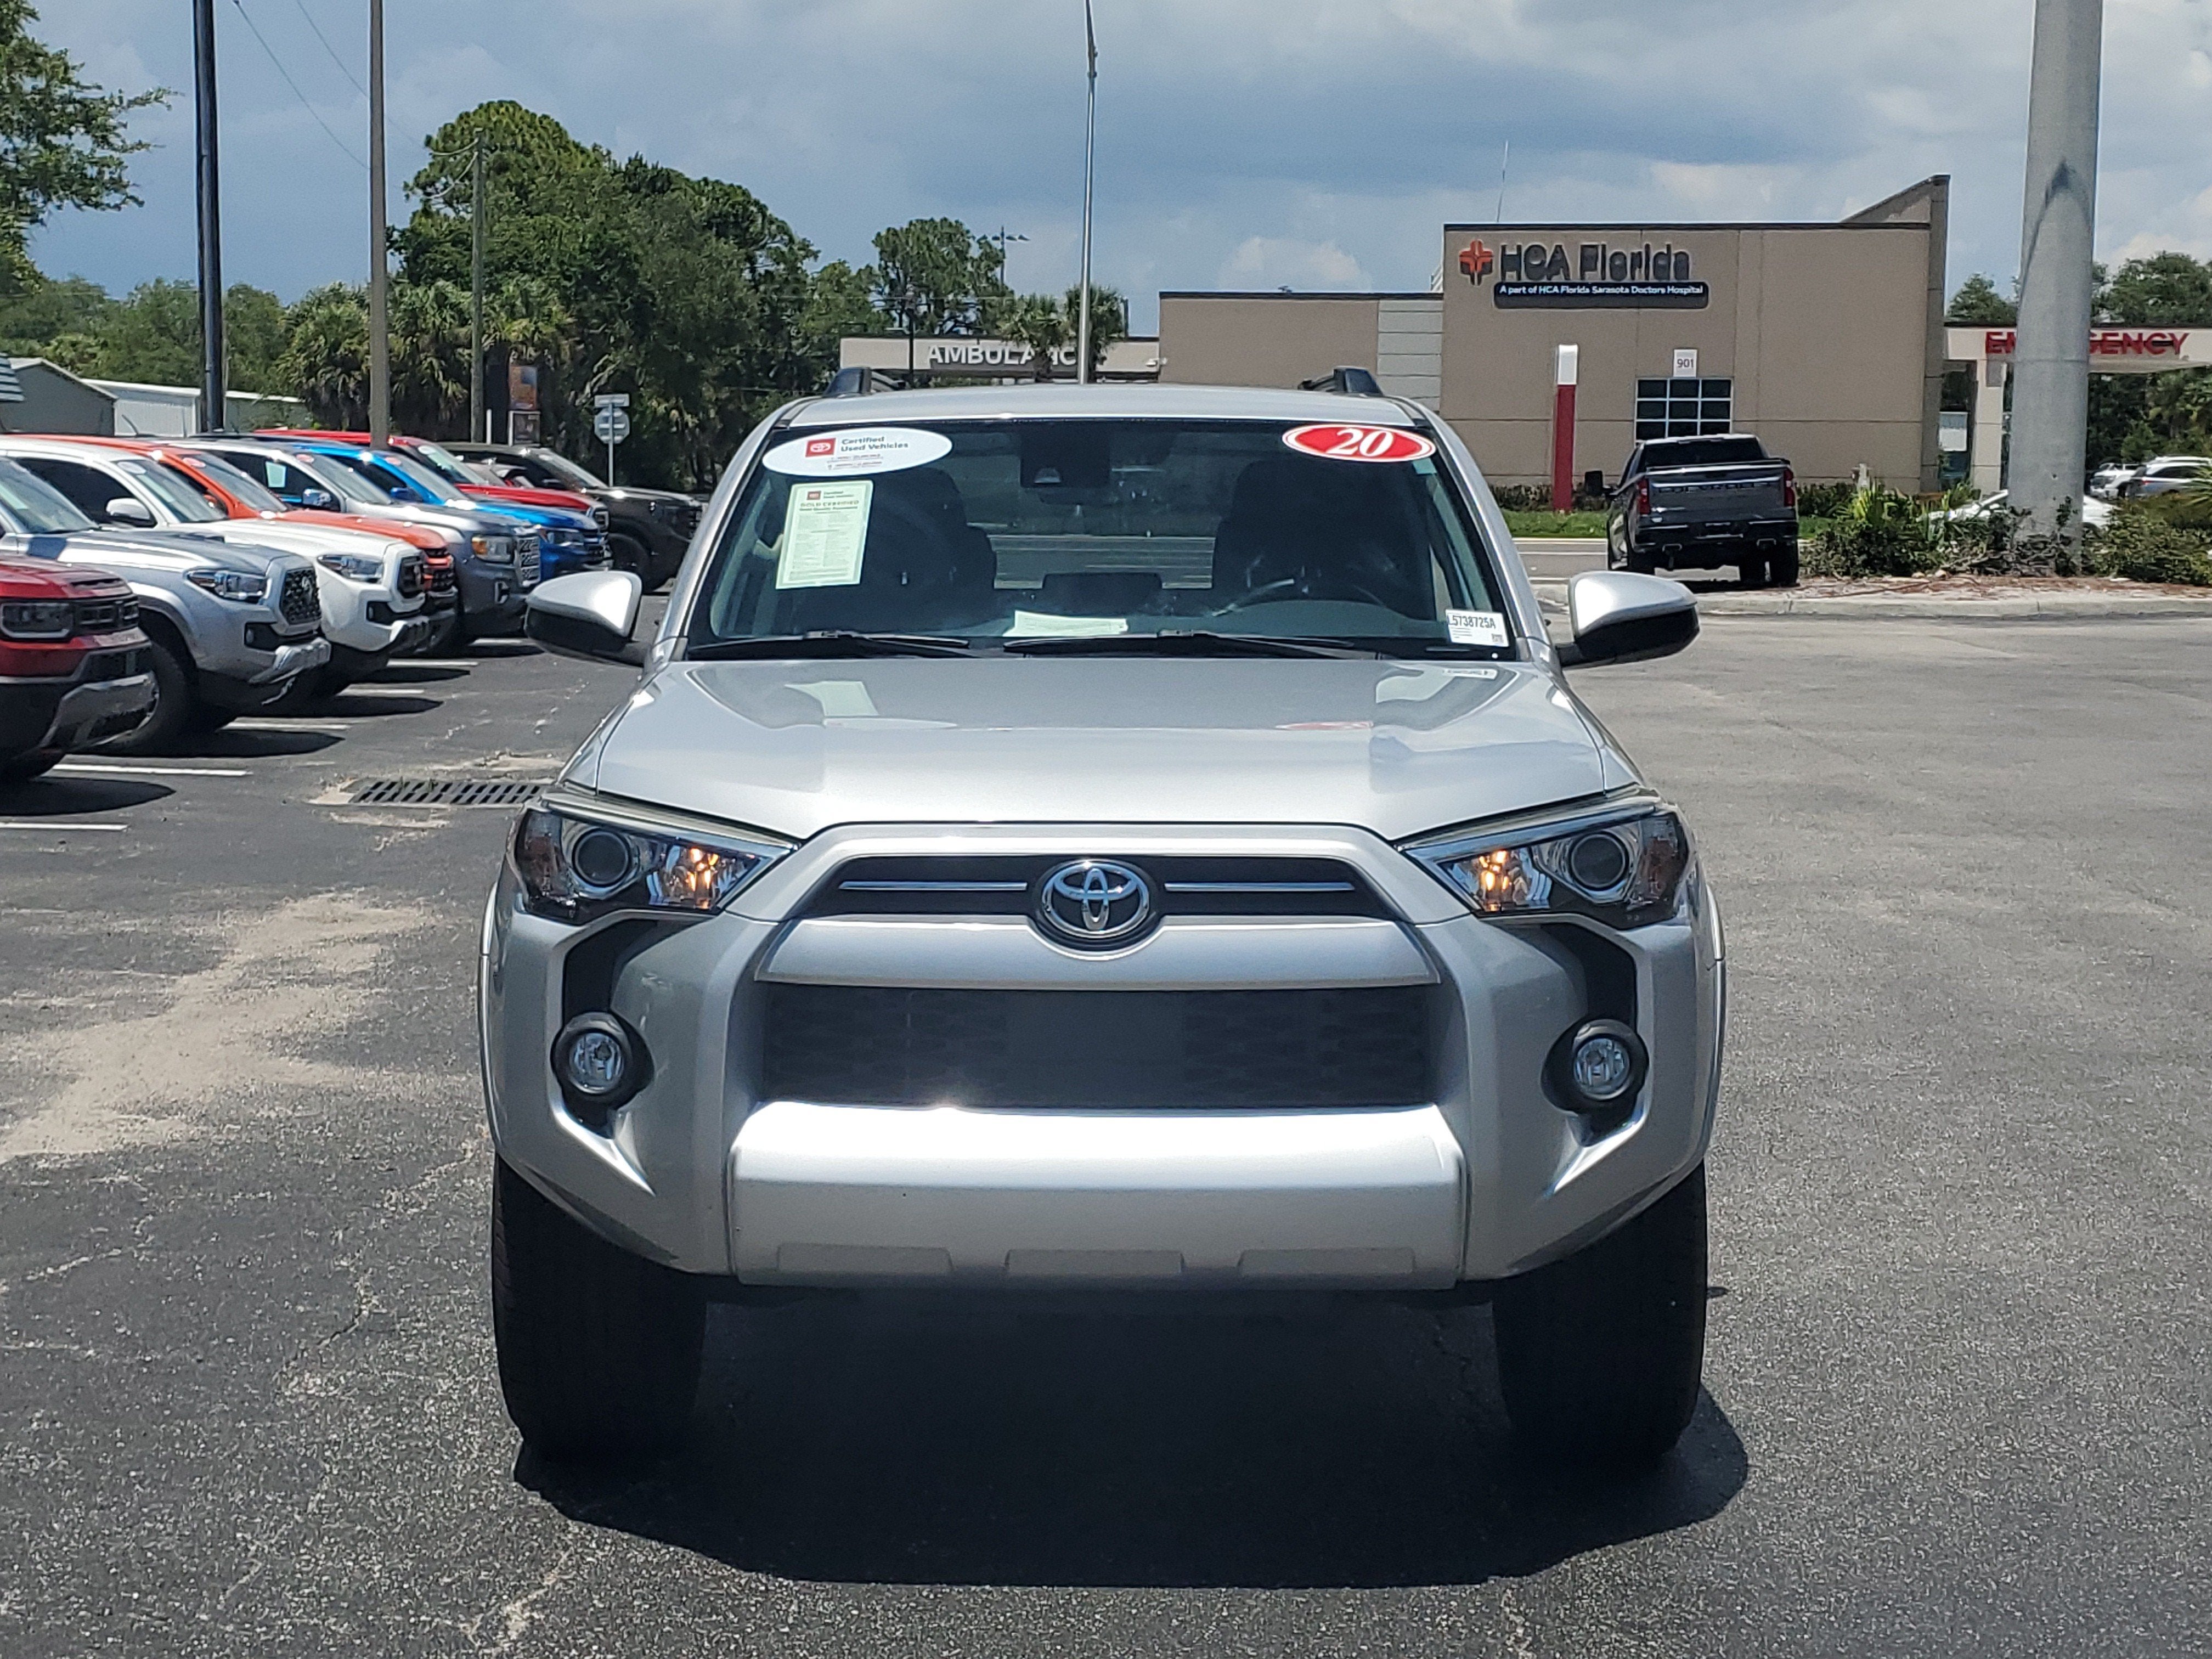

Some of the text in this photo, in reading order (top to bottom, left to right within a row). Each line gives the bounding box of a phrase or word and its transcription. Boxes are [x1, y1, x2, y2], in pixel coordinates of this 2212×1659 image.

[1500, 243, 1690, 280] HCA Florida
[1499, 285, 1506, 294] A
[1508, 286, 1526, 295] part
[1528, 285, 1537, 294] of
[1538, 285, 1559, 294] HCA
[1560, 285, 1590, 294] Florida
[1667, 285, 1703, 295] Hospital
[1677, 359, 1694, 368] 901
[841, 437, 885, 445] Certified
[1326, 427, 1395, 457] 20
